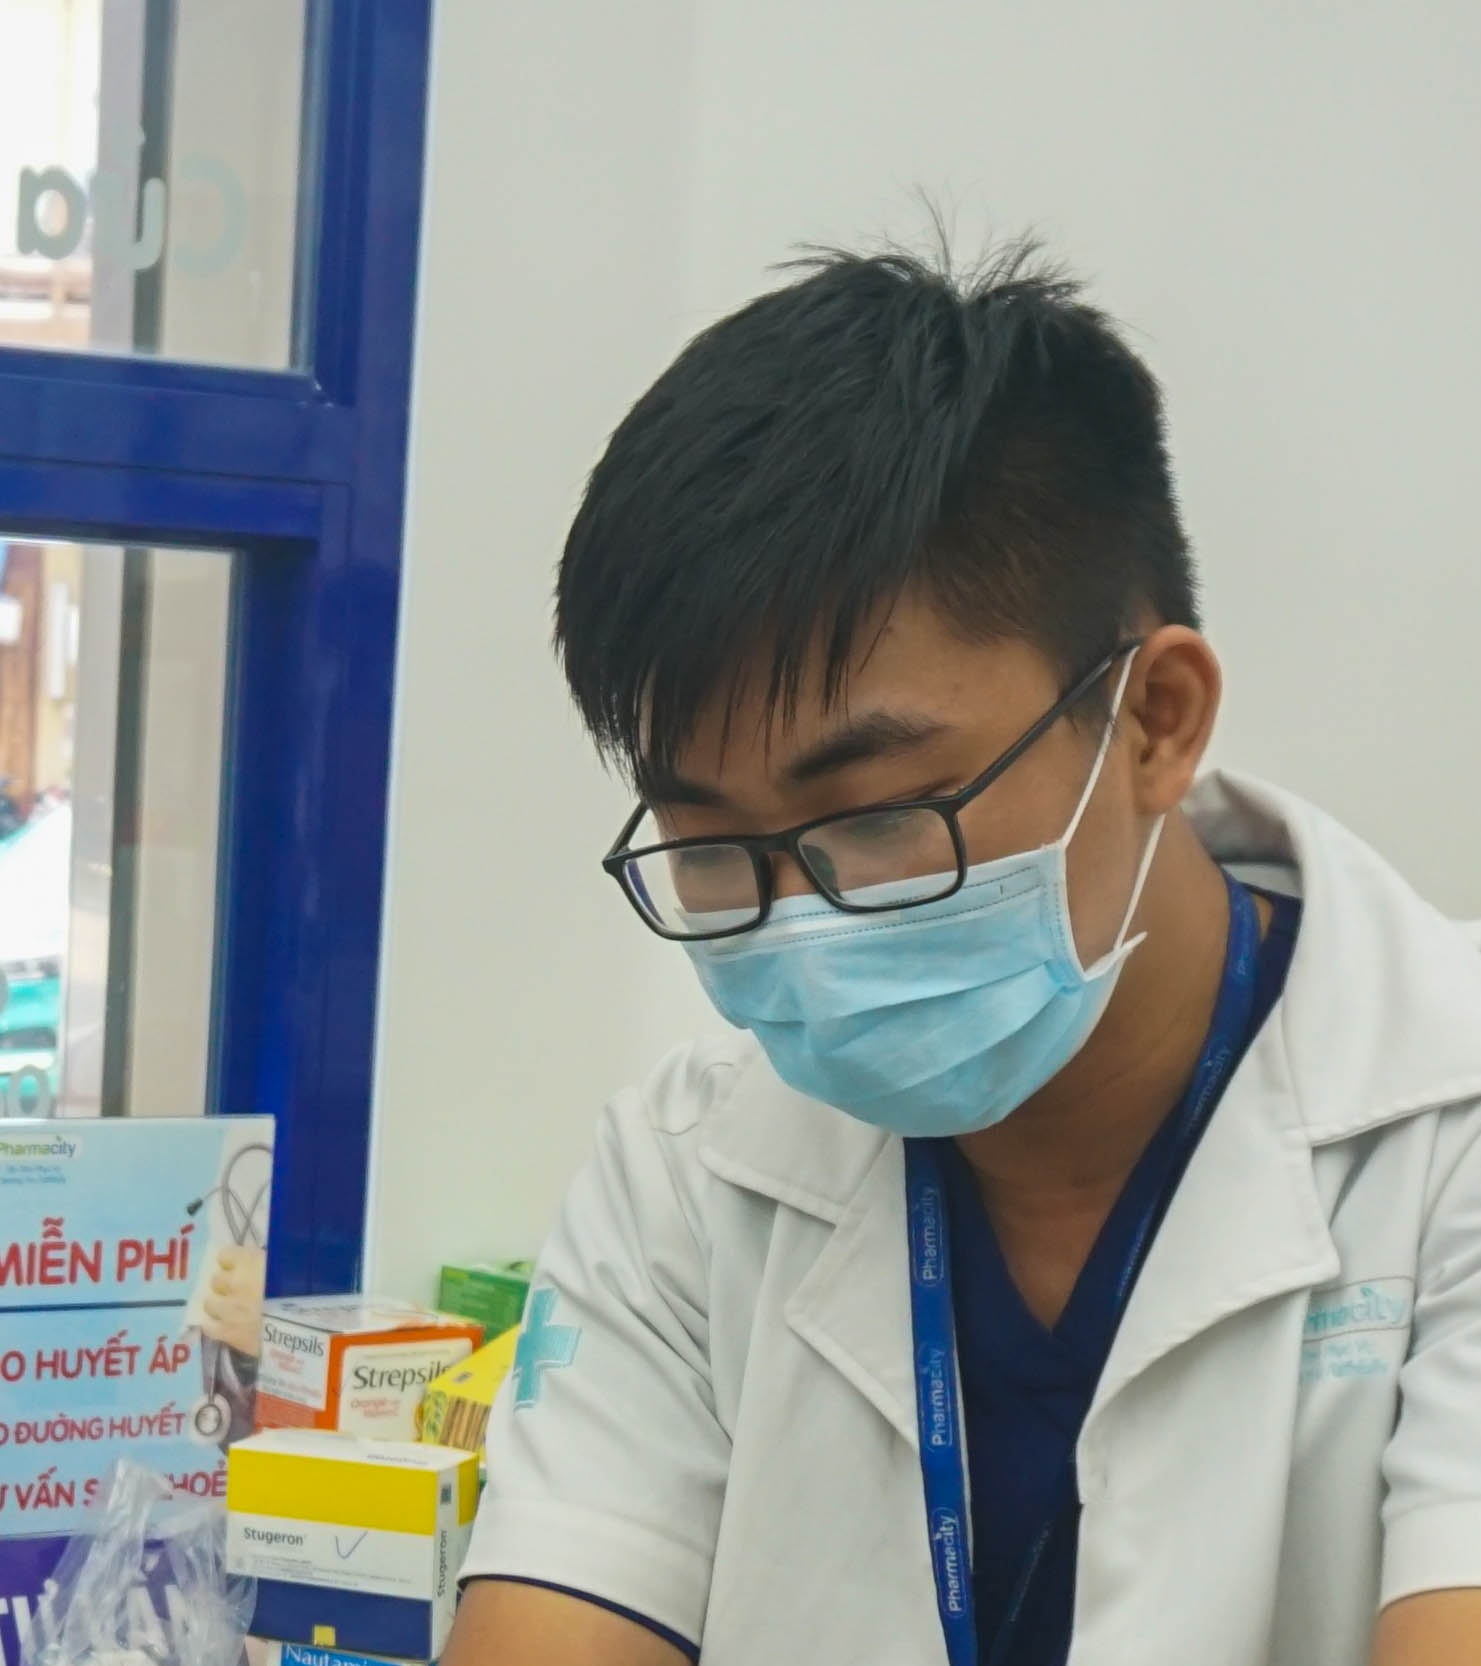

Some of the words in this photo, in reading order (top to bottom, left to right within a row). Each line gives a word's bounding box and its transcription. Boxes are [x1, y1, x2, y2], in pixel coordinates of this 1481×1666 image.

[117, 1225, 196, 1282] PHÍ
[36, 1330, 140, 1379] HUYẾT
[148, 1334, 190, 1376] ÁP
[264, 1323, 325, 1357] Strepsils
[109, 1402, 185, 1439] HUYẾT
[14, 1466, 76, 1511] VẤN
[243, 1527, 303, 1546] Stugeron
[437, 1530, 448, 1598] Stugeron
[941, 1514, 962, 1612] Pharmacity
